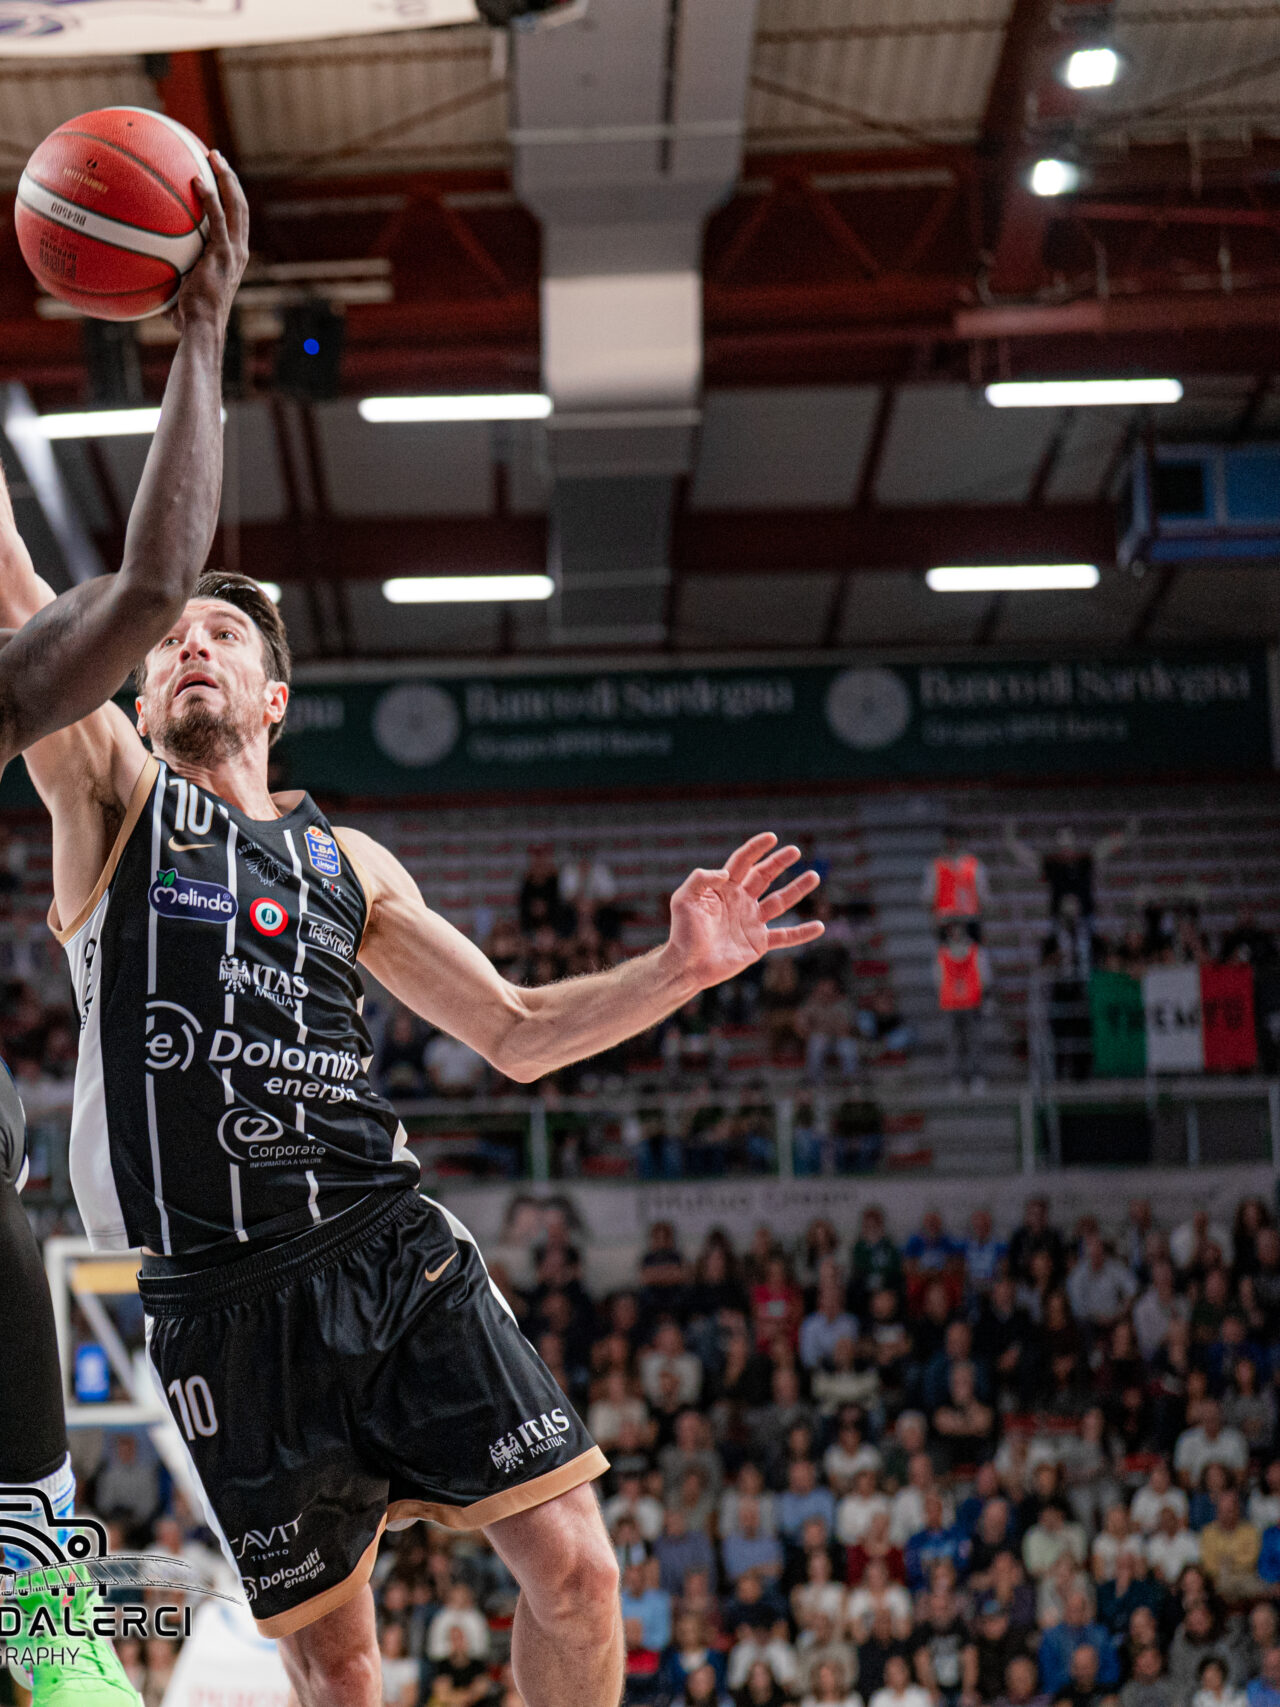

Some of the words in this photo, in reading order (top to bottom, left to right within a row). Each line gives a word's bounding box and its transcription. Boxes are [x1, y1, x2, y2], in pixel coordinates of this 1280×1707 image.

[168, 778, 214, 836] 10
[310, 842, 337, 857] LBA
[153, 886, 233, 914] Melinda
[308, 920, 354, 957] TRENTINO
[252, 963, 310, 998] ITAS
[208, 1029, 360, 1081] Dolomiti
[248, 1144, 327, 1160] Corporate
[249, 1160, 292, 1169] INFORMATICA
[167, 1374, 219, 1441] 10
[516, 1407, 570, 1448] ITAS
[529, 1435, 568, 1459] MUTUA
[230, 1512, 303, 1559] AVIT
[259, 1547, 321, 1591] Dolomiti
[283, 1561, 327, 1590] energia
